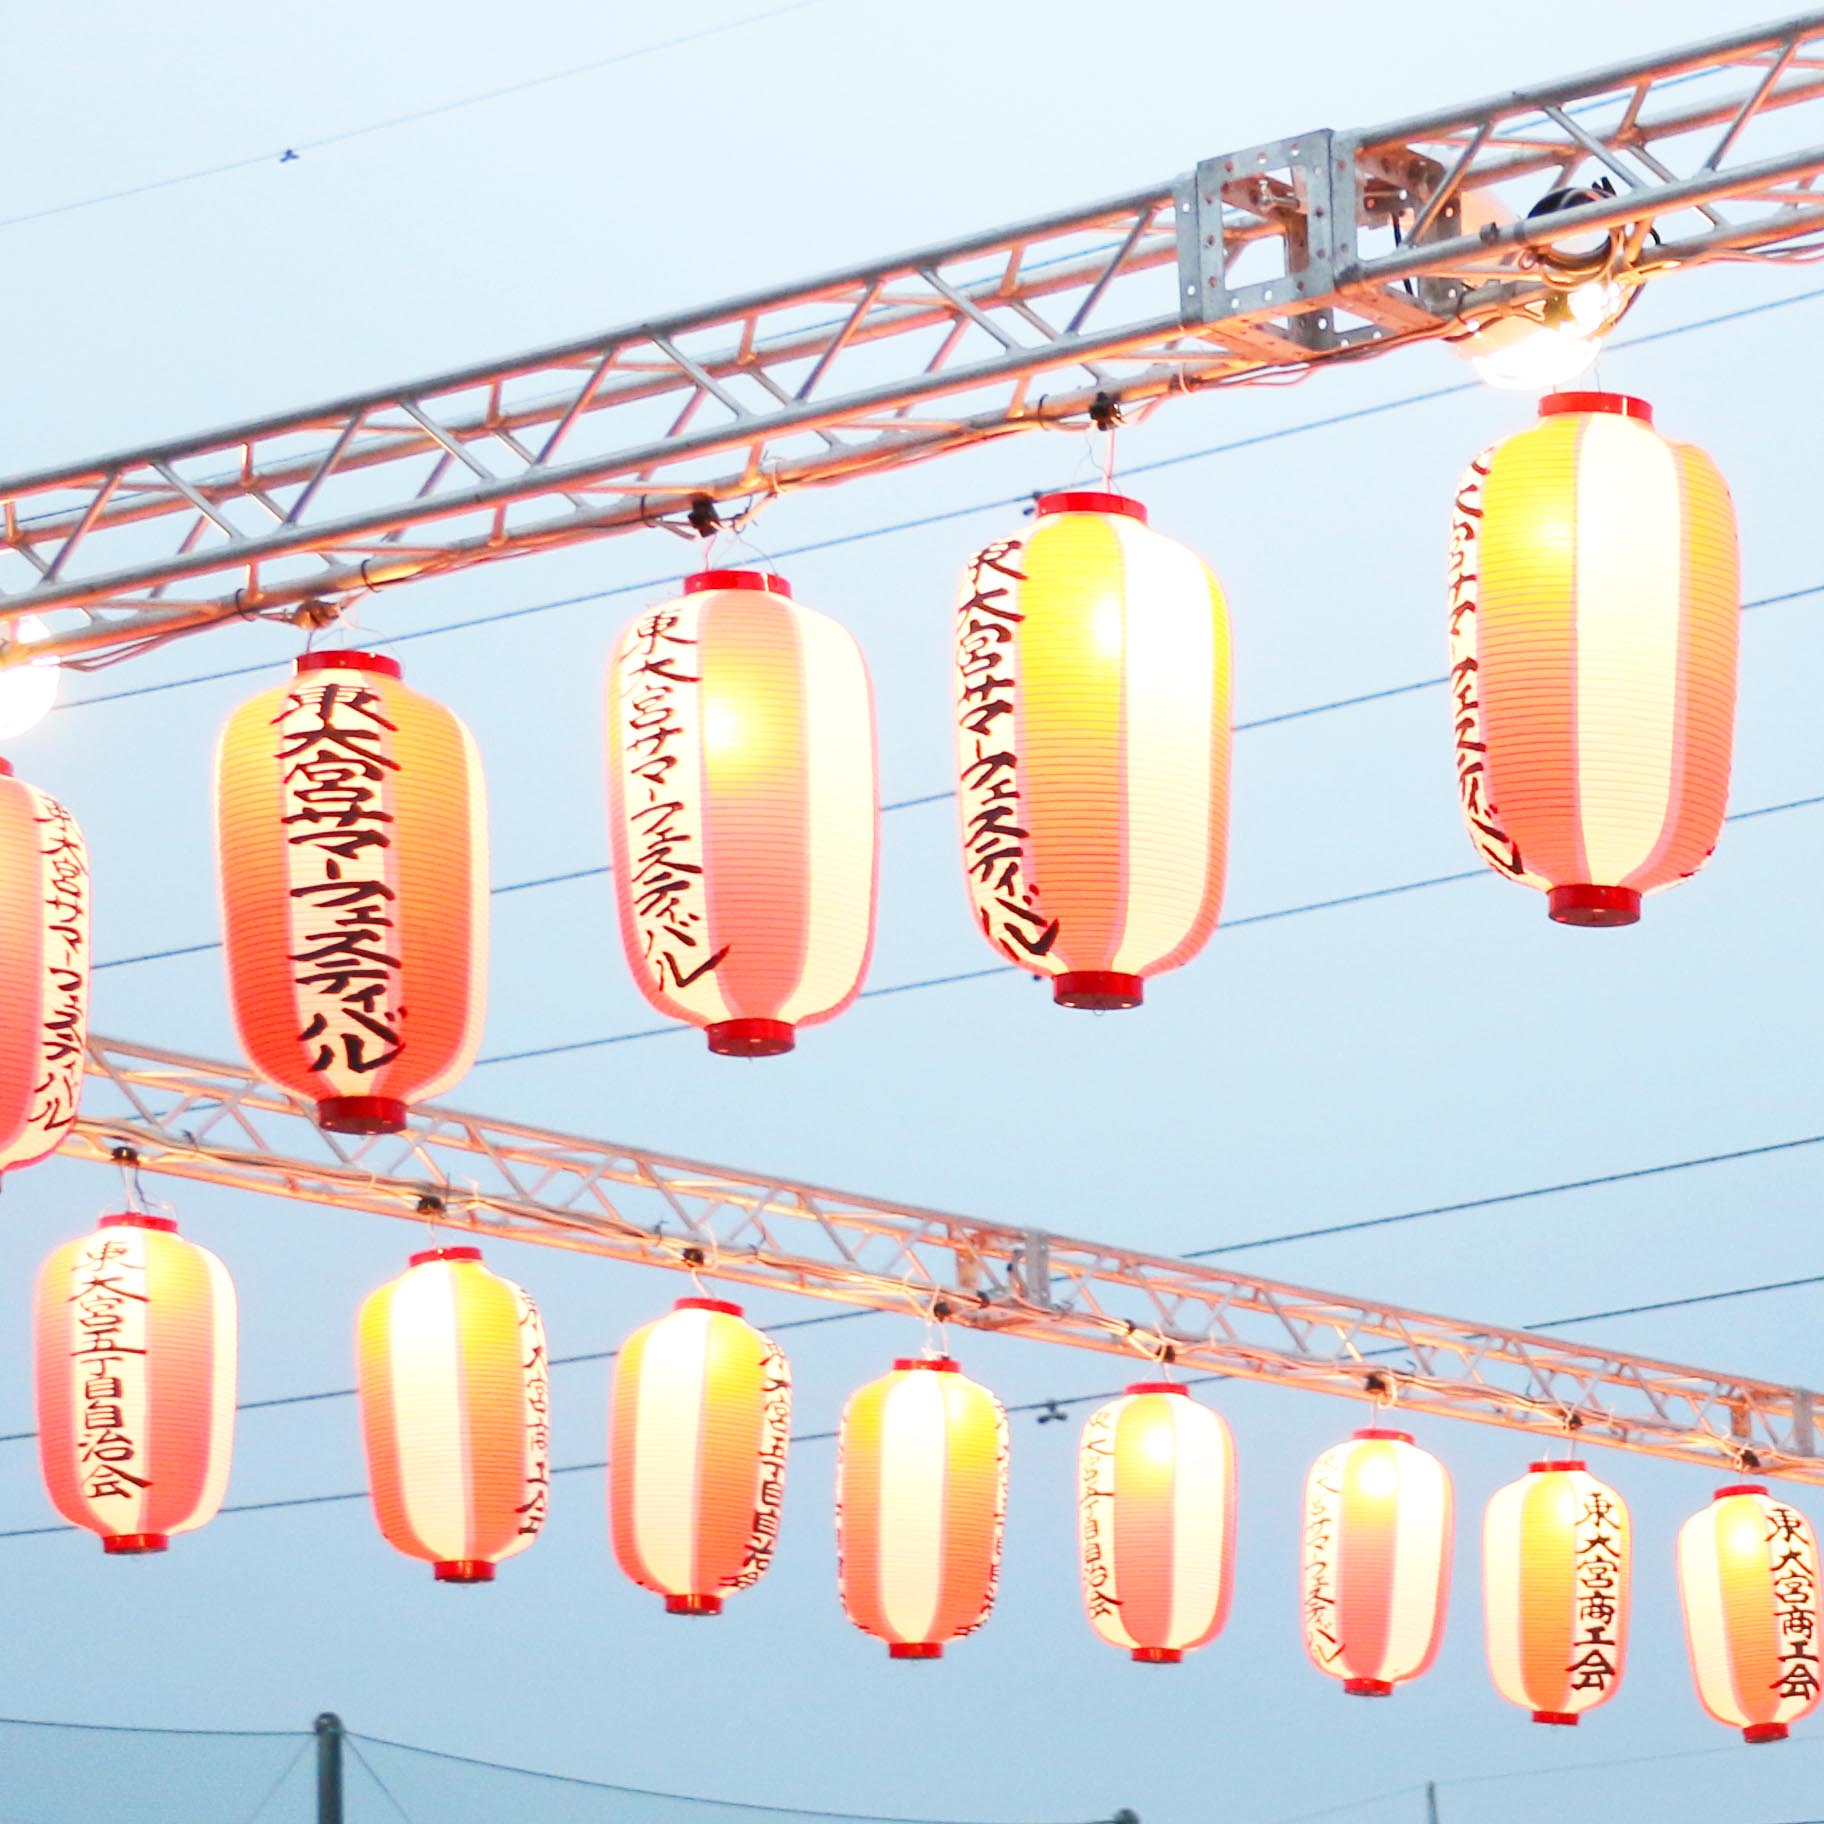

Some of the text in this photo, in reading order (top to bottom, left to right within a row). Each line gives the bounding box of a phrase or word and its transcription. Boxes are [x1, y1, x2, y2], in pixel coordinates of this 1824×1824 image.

[270, 682, 406, 1074] 東大宮サマーフェスティバル
[618, 608, 731, 992] 東大宮サマーフェスティバル
[958, 540, 1059, 961] 東大宮サマーフェスティバル
[68, 1240, 153, 1499] 東大宮五丁目自治会
[1566, 1492, 1621, 1692] 東大宮商工会
[1766, 1507, 1820, 1701] 東大宮商工会
